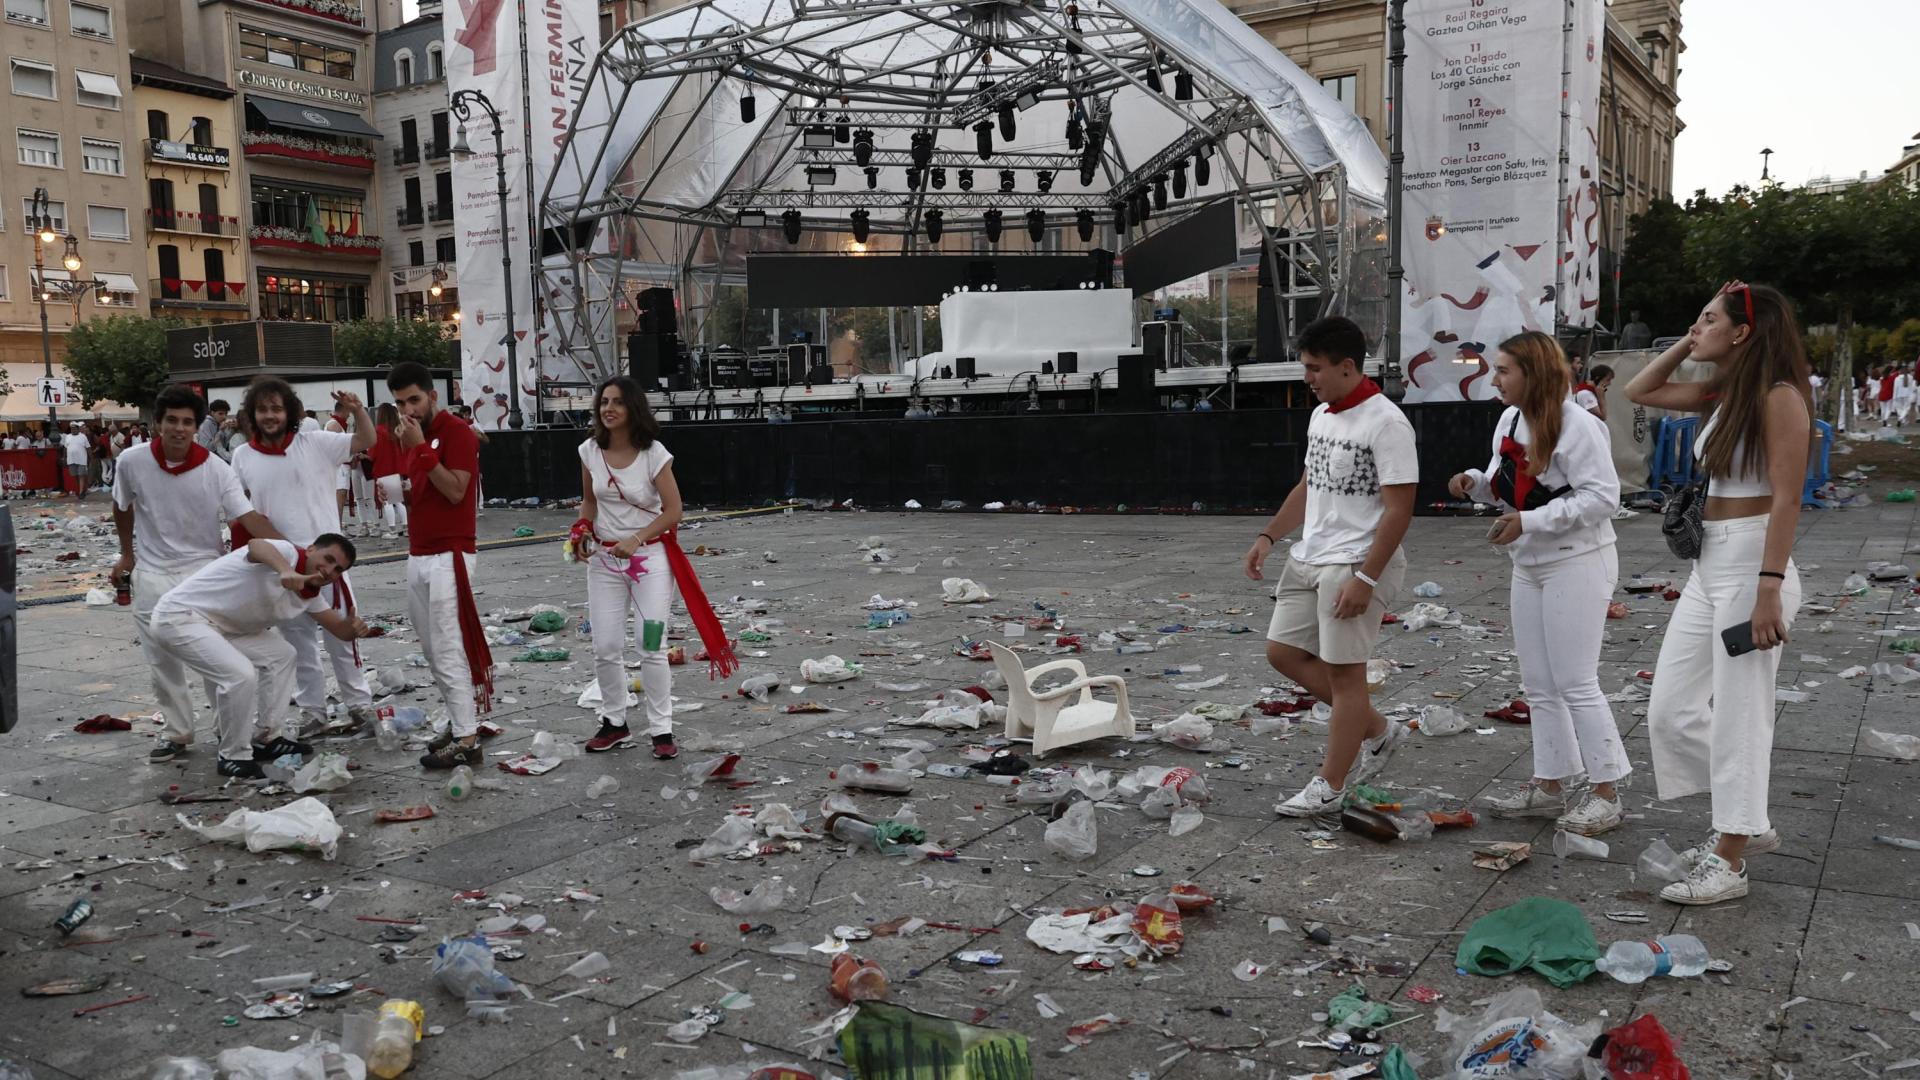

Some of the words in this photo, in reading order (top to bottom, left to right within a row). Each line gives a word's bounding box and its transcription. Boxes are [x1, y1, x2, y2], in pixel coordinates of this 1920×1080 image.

[1446, 13, 1467, 23] Raúl
[1470, 6, 1509, 20] Regaira
[1427, 26, 1463, 37] Gaztea
[1467, 19, 1497, 32] Oihan
[1501, 15, 1527, 26] Vega
[1470, 43, 1481, 52] 11
[1444, 57, 1461, 67] Jon
[1465, 51, 1507, 65] Delgado
[1431, 71, 1446, 80] Los
[1449, 68, 1462, 77] 40
[1466, 63, 1499, 75] Classic
[1503, 60, 1521, 70] con
[254, 75, 286, 90] NUEVO
[289, 80, 326, 97] CASINO
[329, 89, 363, 104] ESLAVA
[1439, 78, 1465, 91] Jorge
[1469, 73, 1512, 86] Sánchez
[1469, 98, 1481, 108] 12
[1443, 109, 1475, 123] Imanol
[1478, 107, 1507, 120] Reyes
[1459, 121, 1489, 132] Innmir
[1468, 142, 1481, 151] 13
[1441, 156, 1462, 166] Oier
[1466, 152, 1507, 164] Lazcano
[1439, 164, 1482, 179] Megastar
[1486, 164, 1502, 173] con
[1505, 159, 1528, 169] Safu,
[1532, 156, 1548, 168] Iris,
[1401, 180, 1441, 192] Jonathan
[1445, 177, 1467, 189] Pons,
[1471, 174, 1500, 186] Sergio
[1503, 169, 1548, 182] Blázquez
[1489, 216, 1520, 225] Iruñeko
